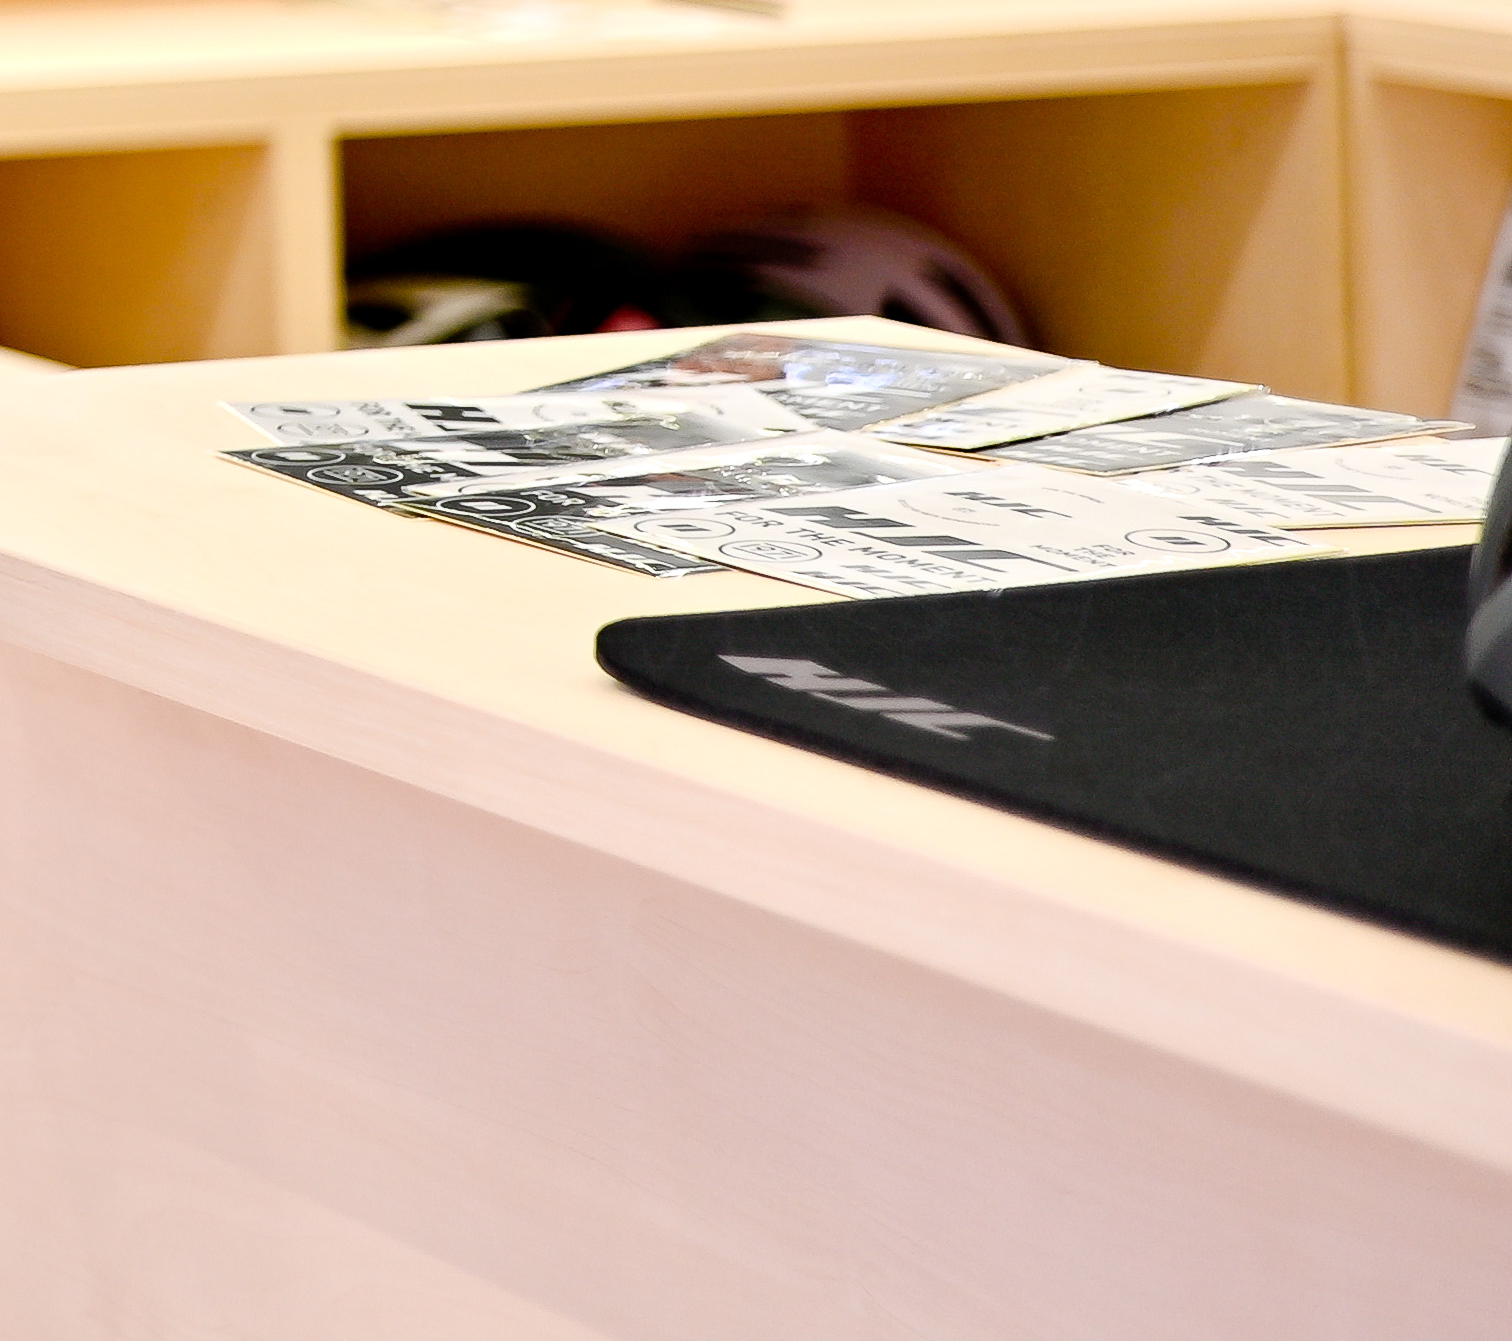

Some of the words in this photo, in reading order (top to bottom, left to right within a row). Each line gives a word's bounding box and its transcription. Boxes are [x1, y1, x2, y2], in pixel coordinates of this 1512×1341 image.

[942, 490, 1075, 519] HJC
[1176, 515, 1312, 548] HJC
[715, 510, 785, 529] FOR
[785, 527, 855, 548] THE
[848, 546, 998, 584] MOMENT
[761, 505, 1081, 574] HJC
[717, 653, 1058, 742] HJC
